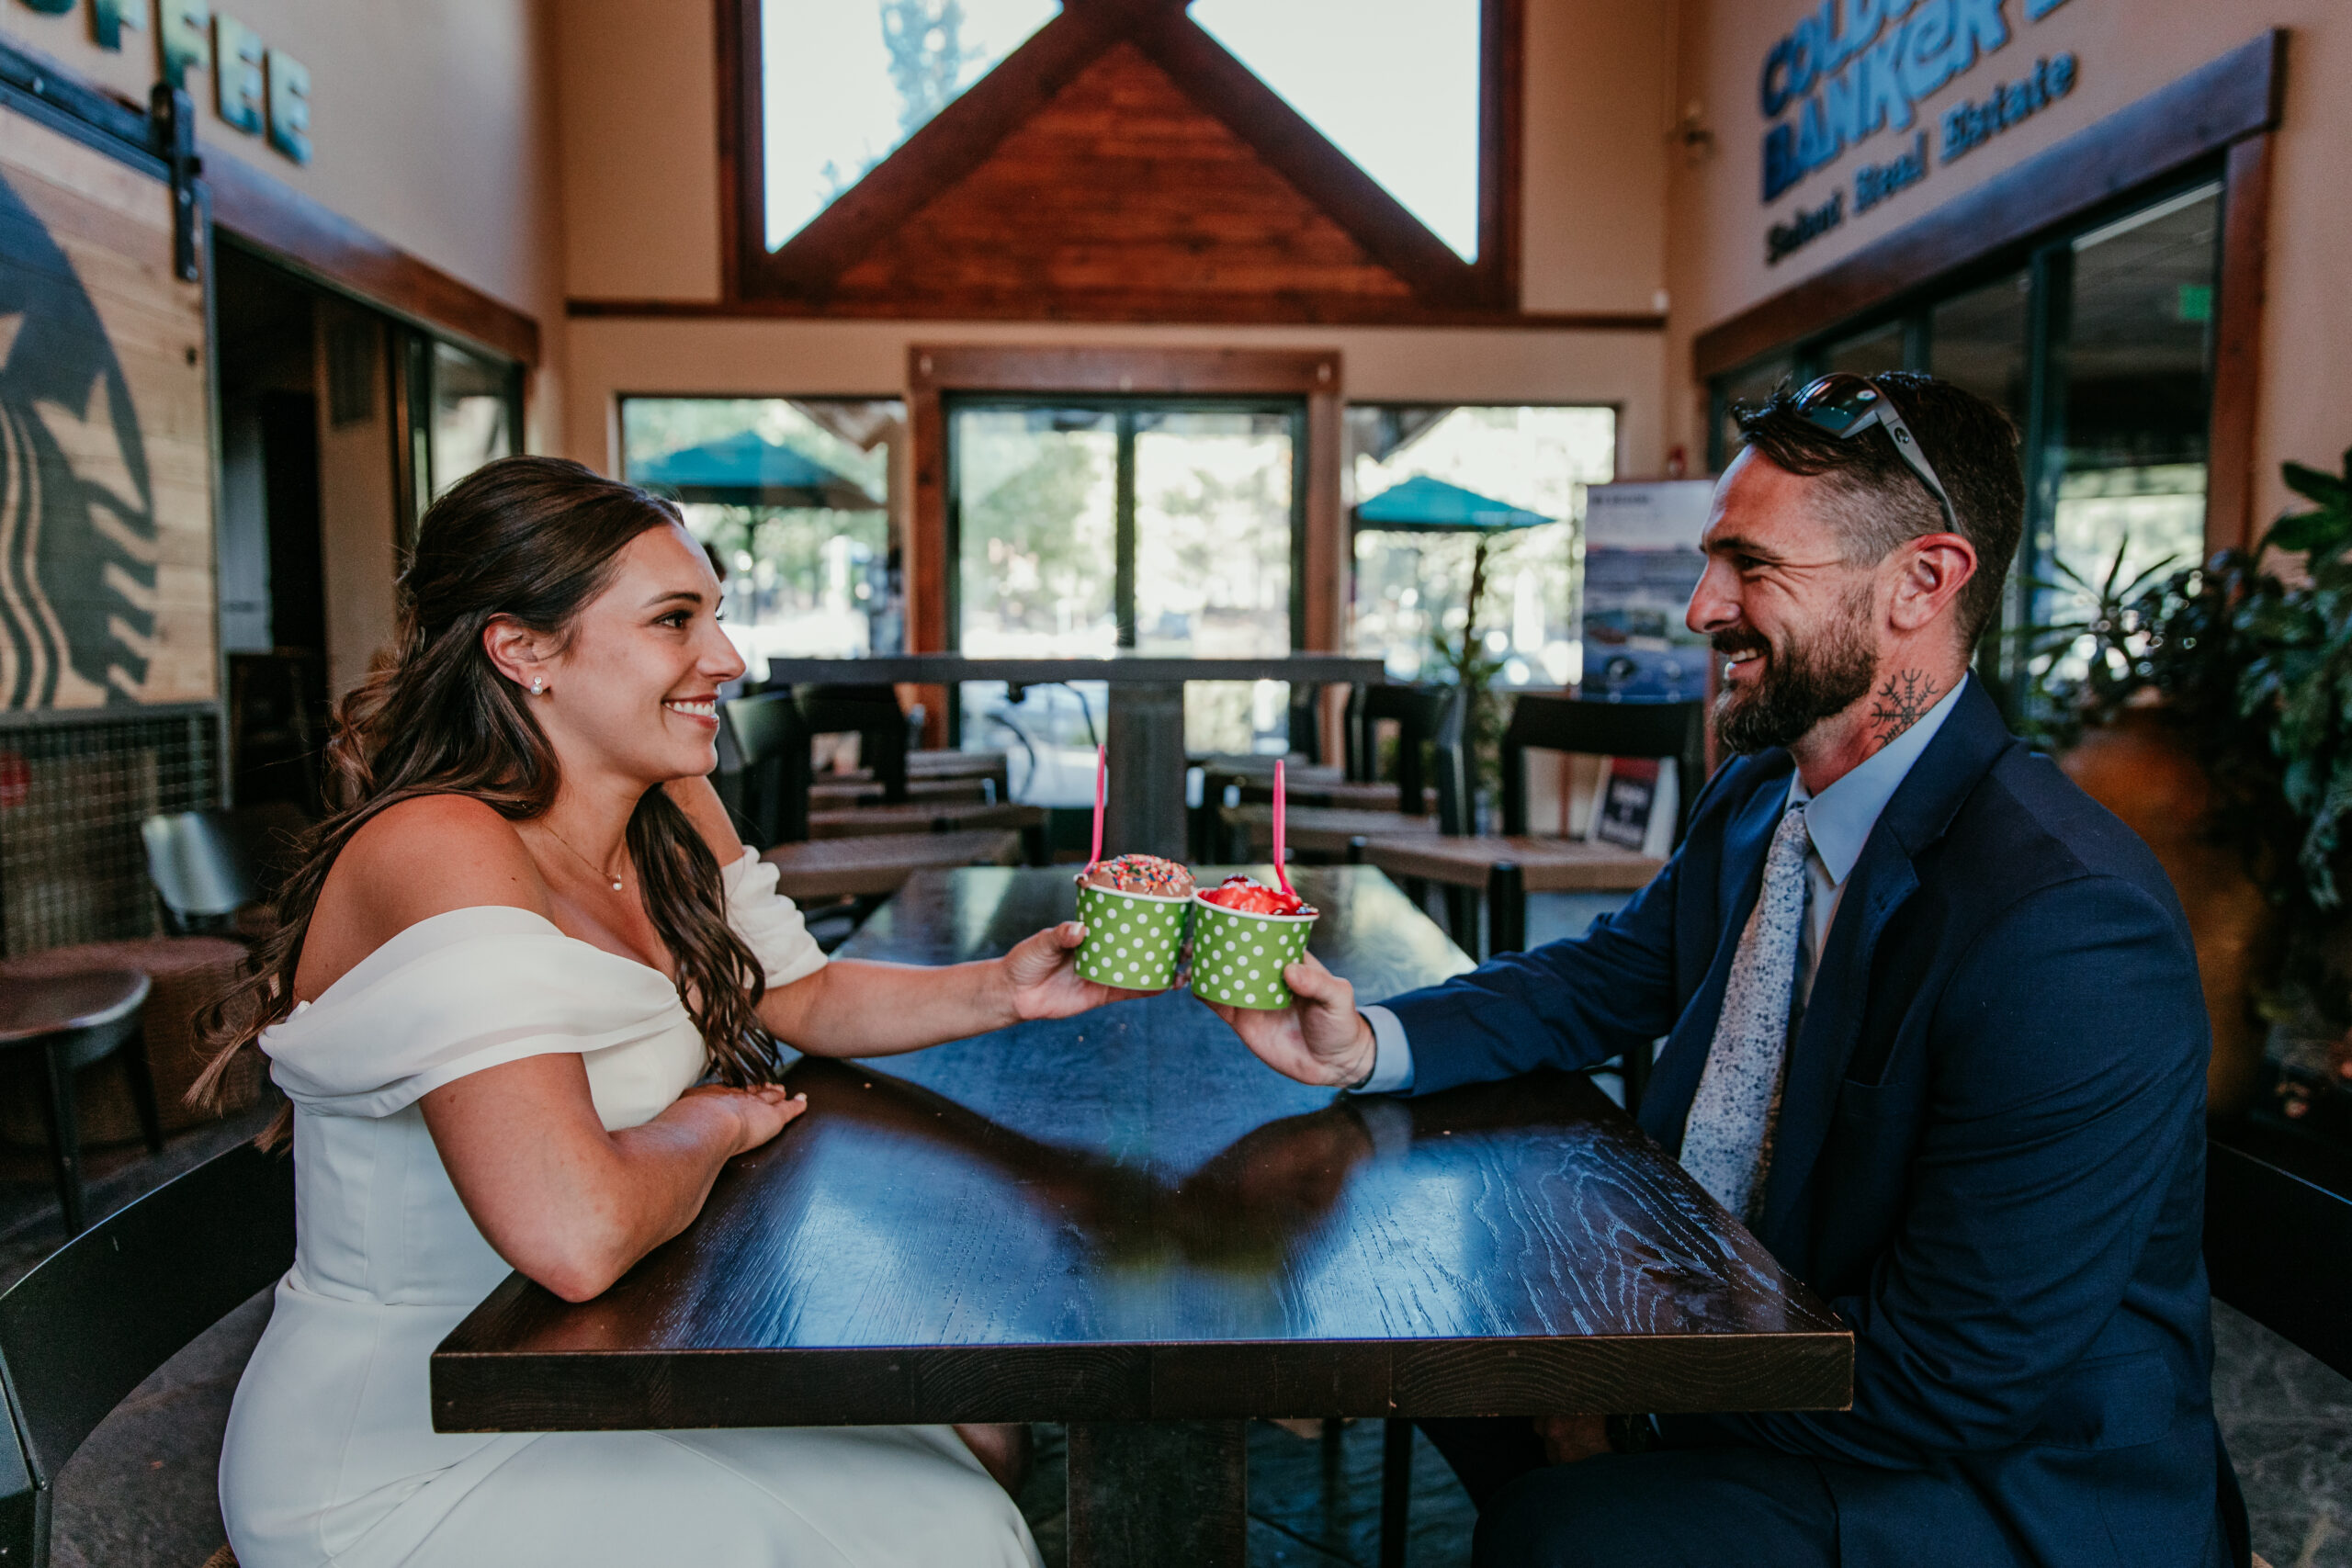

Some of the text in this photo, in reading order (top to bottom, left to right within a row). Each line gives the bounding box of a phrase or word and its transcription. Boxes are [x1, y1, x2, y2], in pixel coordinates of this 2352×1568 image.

[13, 0, 315, 167] FEE
[1761, 0, 1924, 118] COLD
[1853, 130, 1928, 216] Real
[1939, 51, 2079, 164] Estate
